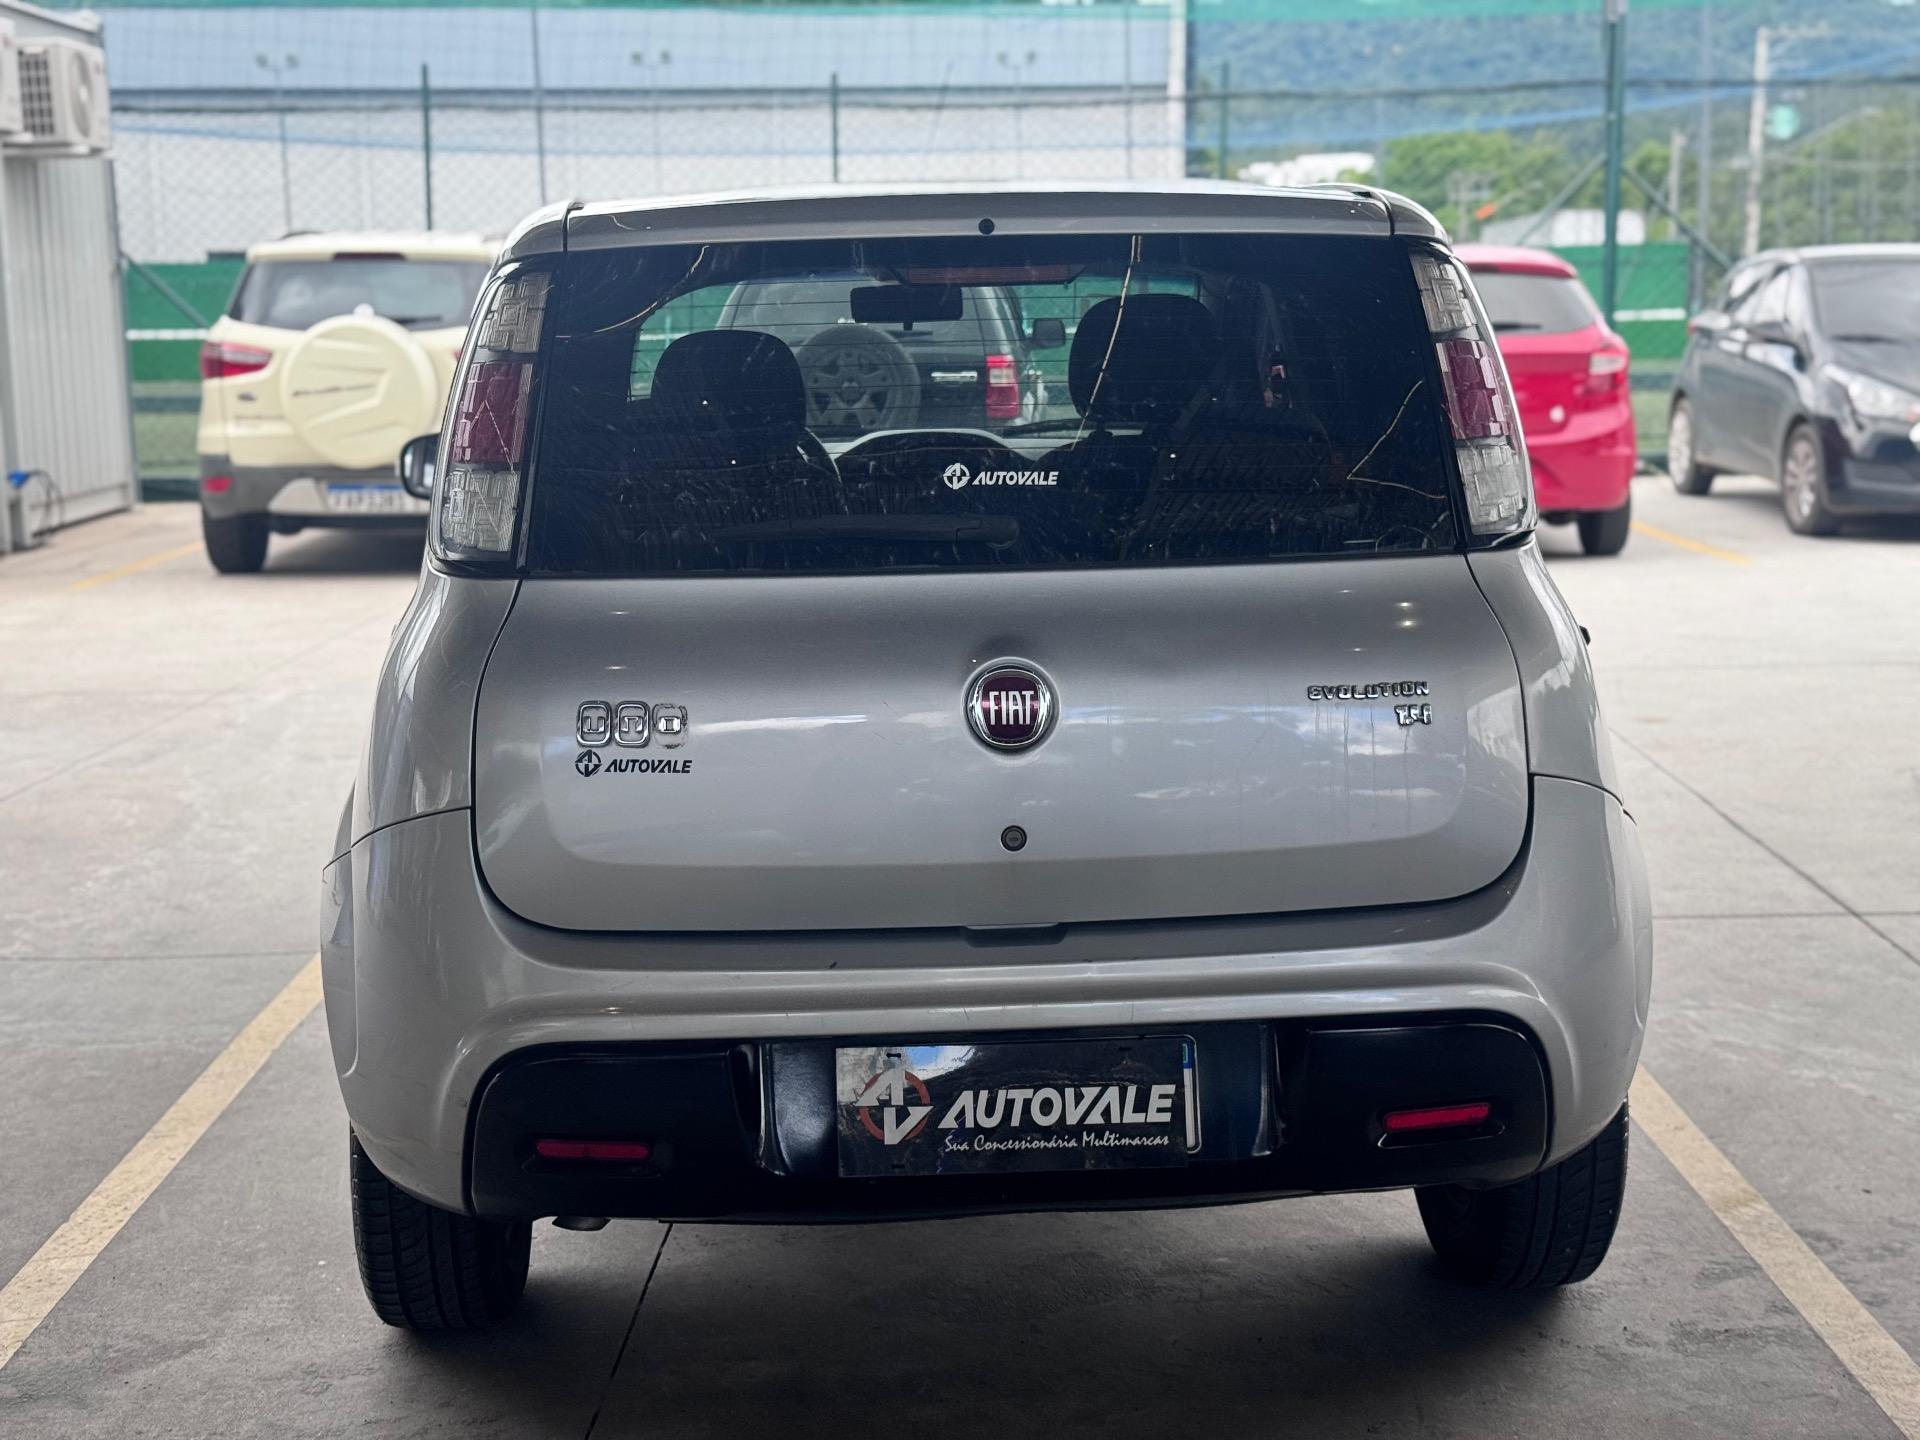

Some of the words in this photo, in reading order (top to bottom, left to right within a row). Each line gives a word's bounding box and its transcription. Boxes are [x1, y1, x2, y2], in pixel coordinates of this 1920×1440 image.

[972, 471, 1059, 486] AUTOVALE
[1307, 681, 1430, 700] EVOLUTION
[989, 691, 1034, 725] FIAT
[604, 759, 693, 773] AUTOVALE
[938, 1084, 1177, 1128] AUTOVALE
[945, 1135, 970, 1152] Sua
[974, 1134, 1079, 1151] Concessionária
[1081, 1131, 1170, 1148] Multimarcas
